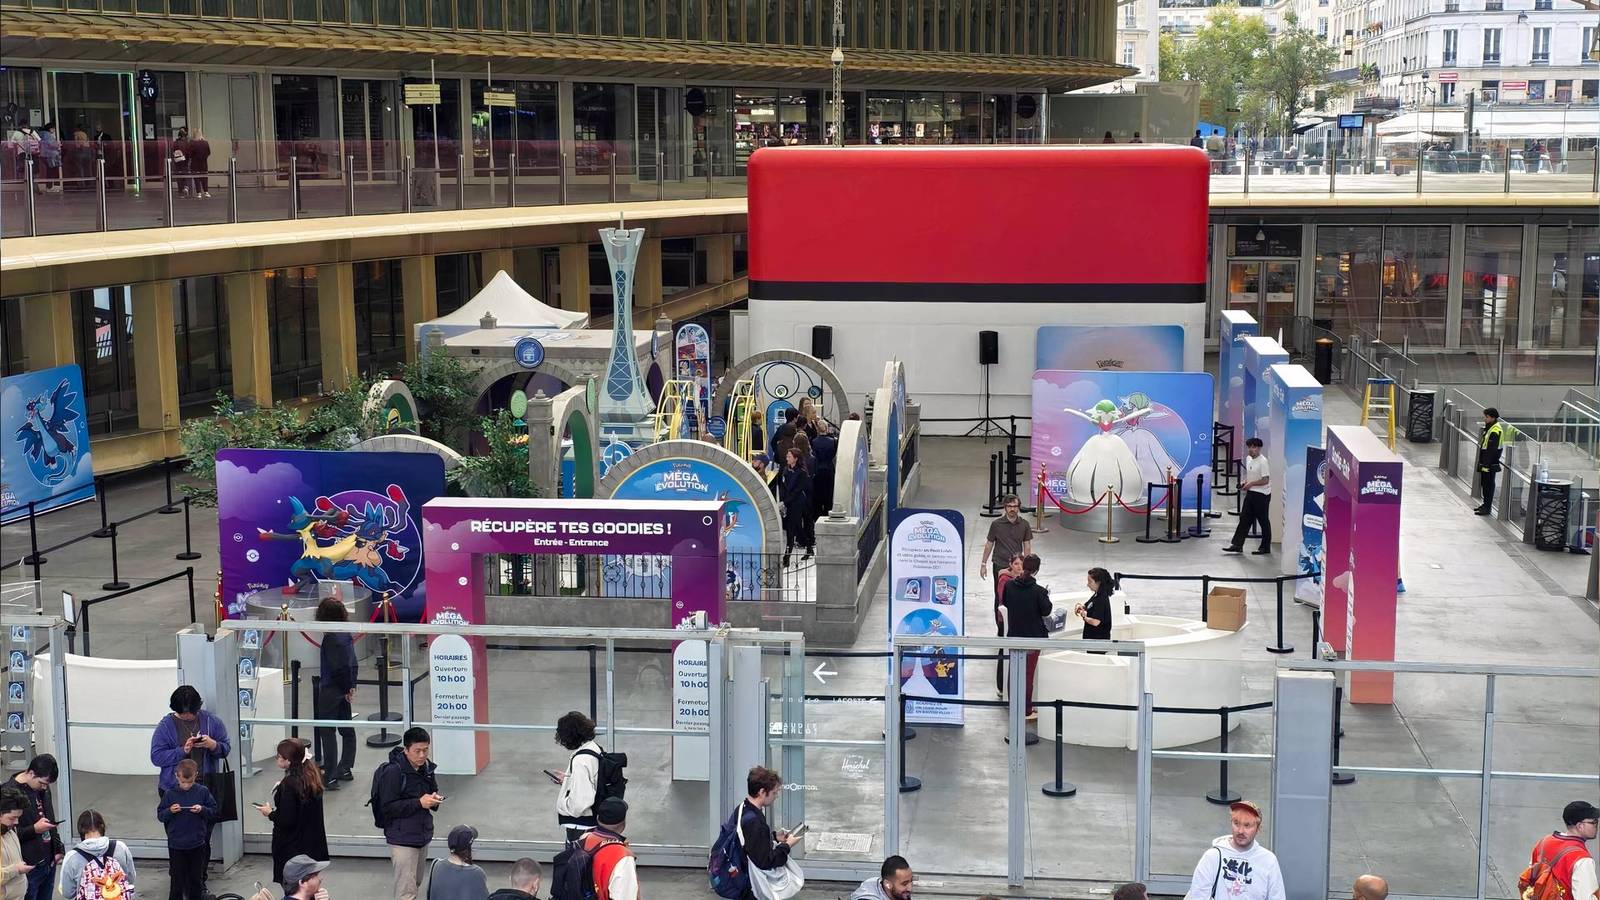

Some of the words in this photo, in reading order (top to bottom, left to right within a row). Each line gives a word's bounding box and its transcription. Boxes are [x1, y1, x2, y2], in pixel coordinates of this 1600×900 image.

[663, 469, 699, 482] MÉGA
[471, 519, 556, 533] RÉCUPÈRE
[559, 522, 589, 533] TES
[592, 522, 664, 535] GOODIES
[666, 523, 672, 535] !
[534, 538, 564, 546] Entrée
[569, 538, 609, 547] Entrance
[678, 659, 707, 667] HORAIRE
[842, 757, 870, 771] Herschel
